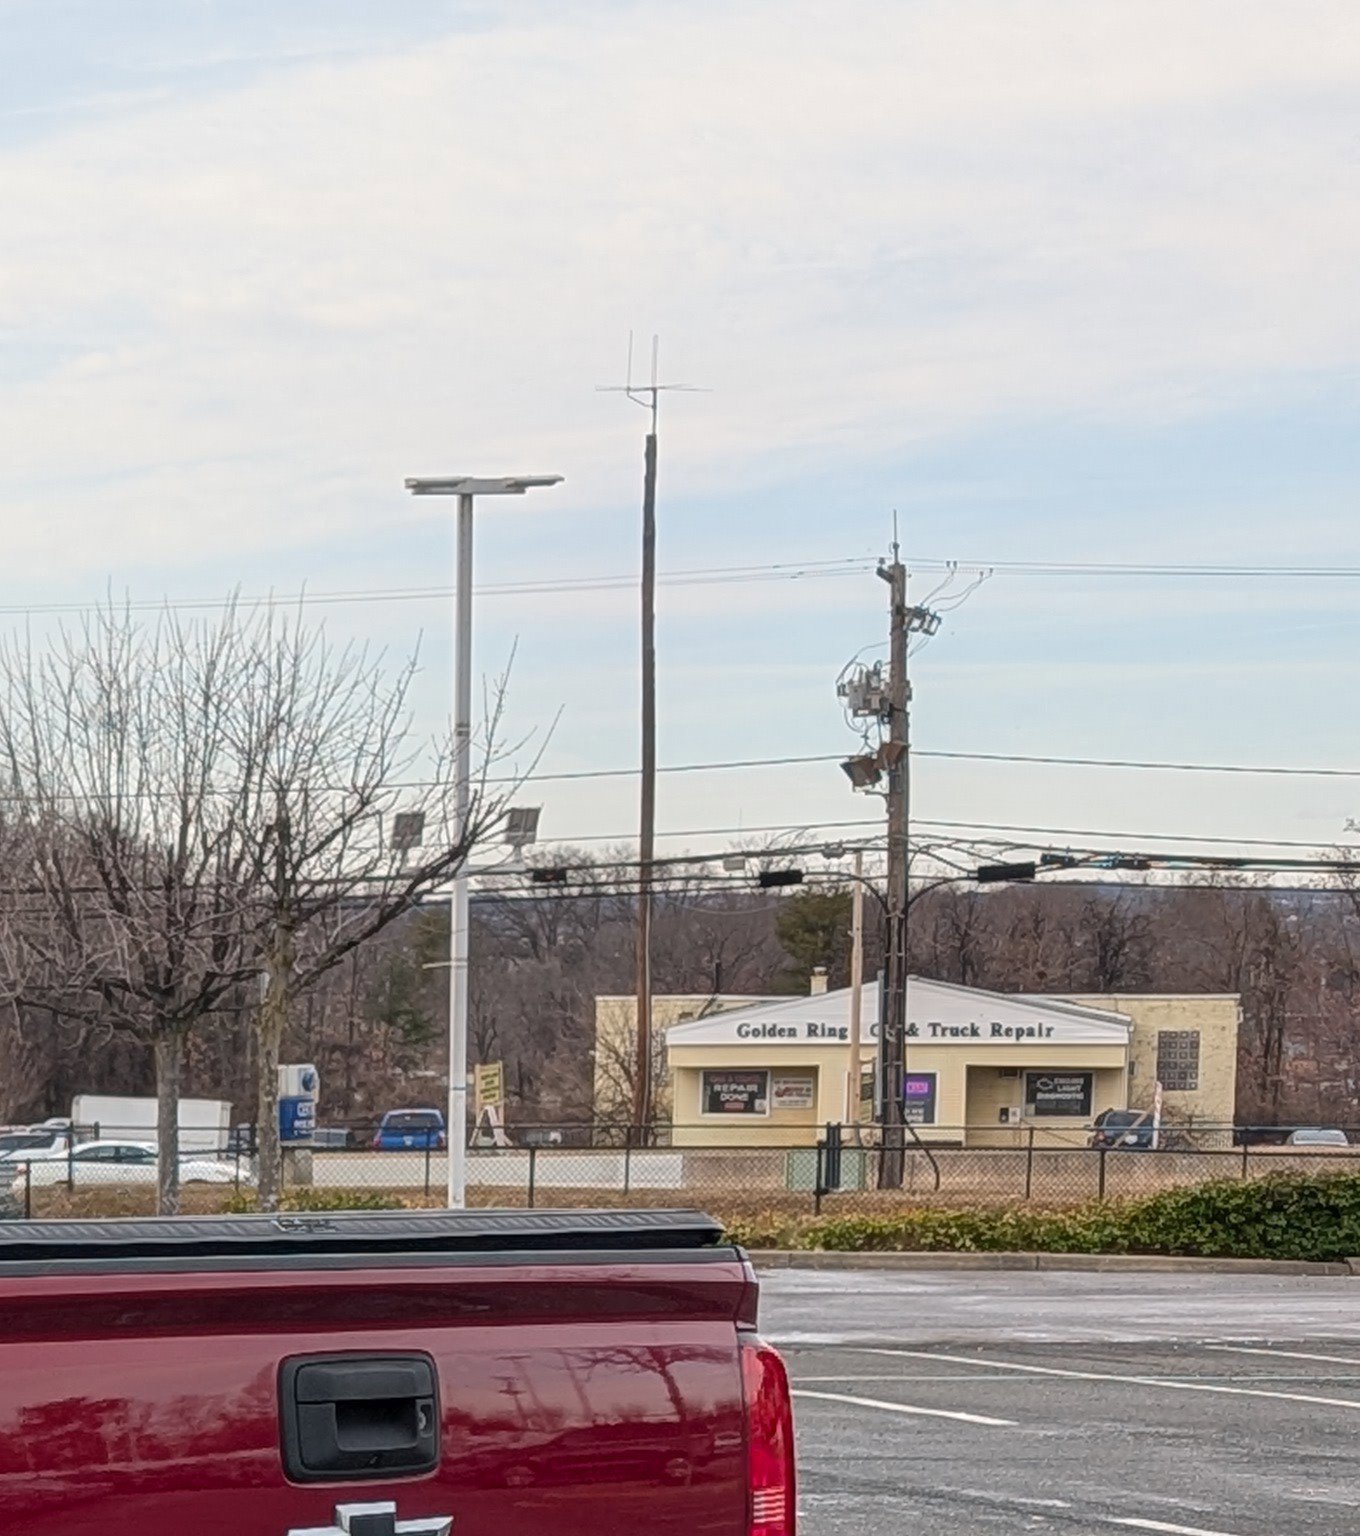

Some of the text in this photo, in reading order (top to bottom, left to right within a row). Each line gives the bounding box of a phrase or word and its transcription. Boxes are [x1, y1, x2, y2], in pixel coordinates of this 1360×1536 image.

[736, 1022, 798, 1038] Golden
[806, 1022, 849, 1040] Ring
[907, 1022, 920, 1038] &
[927, 1022, 982, 1038] Truck
[990, 1022, 1055, 1041] Repair
[713, 1083, 758, 1093] REPAIR
[720, 1092, 749, 1102] DONE
